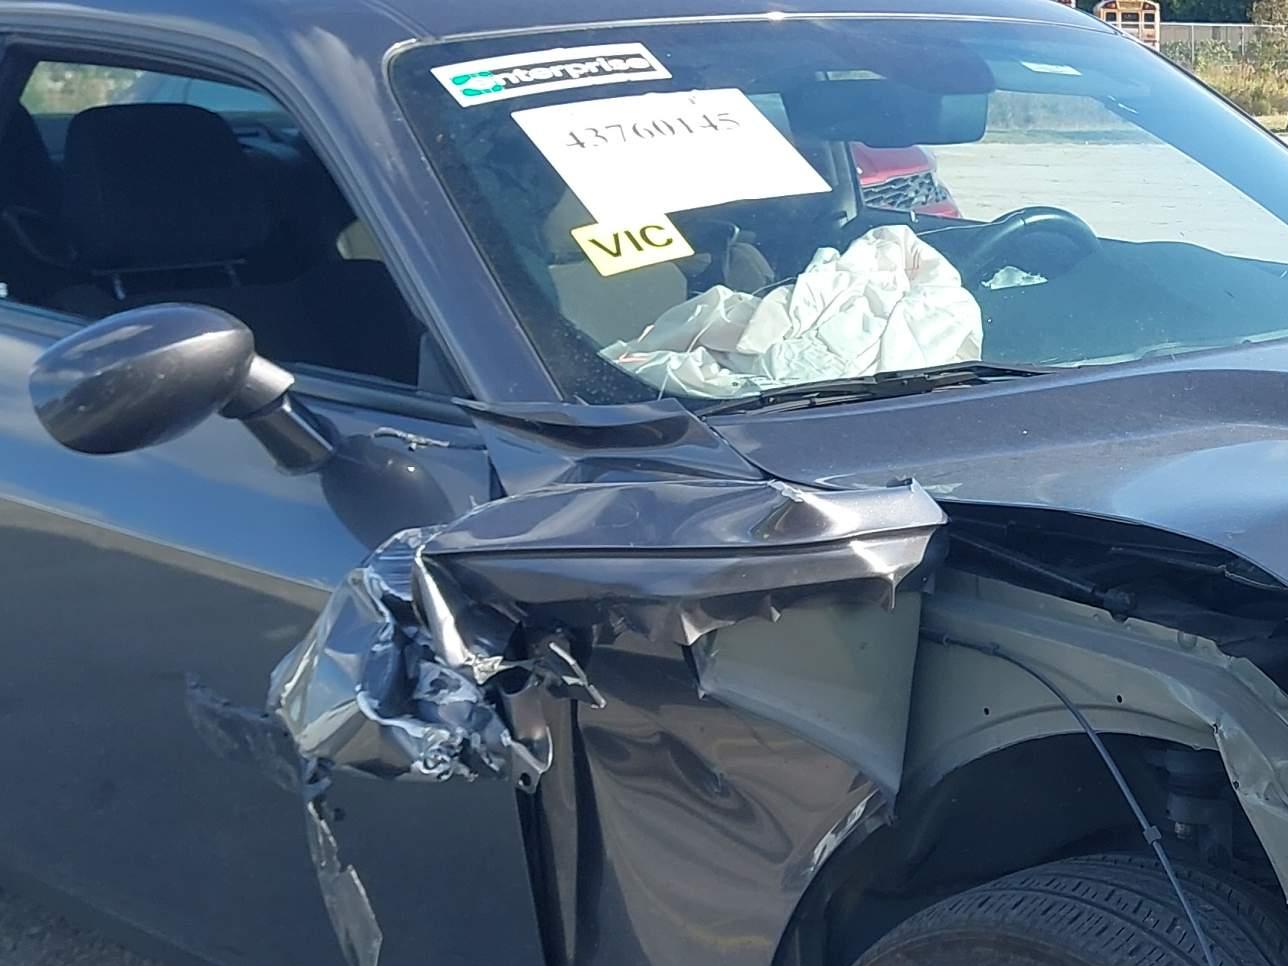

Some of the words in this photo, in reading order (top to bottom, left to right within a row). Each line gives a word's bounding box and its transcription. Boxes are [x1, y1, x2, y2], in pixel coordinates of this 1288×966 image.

[456, 56, 651, 95] enterprise
[565, 112, 741, 149] 43760145
[588, 225, 673, 258] VIC
